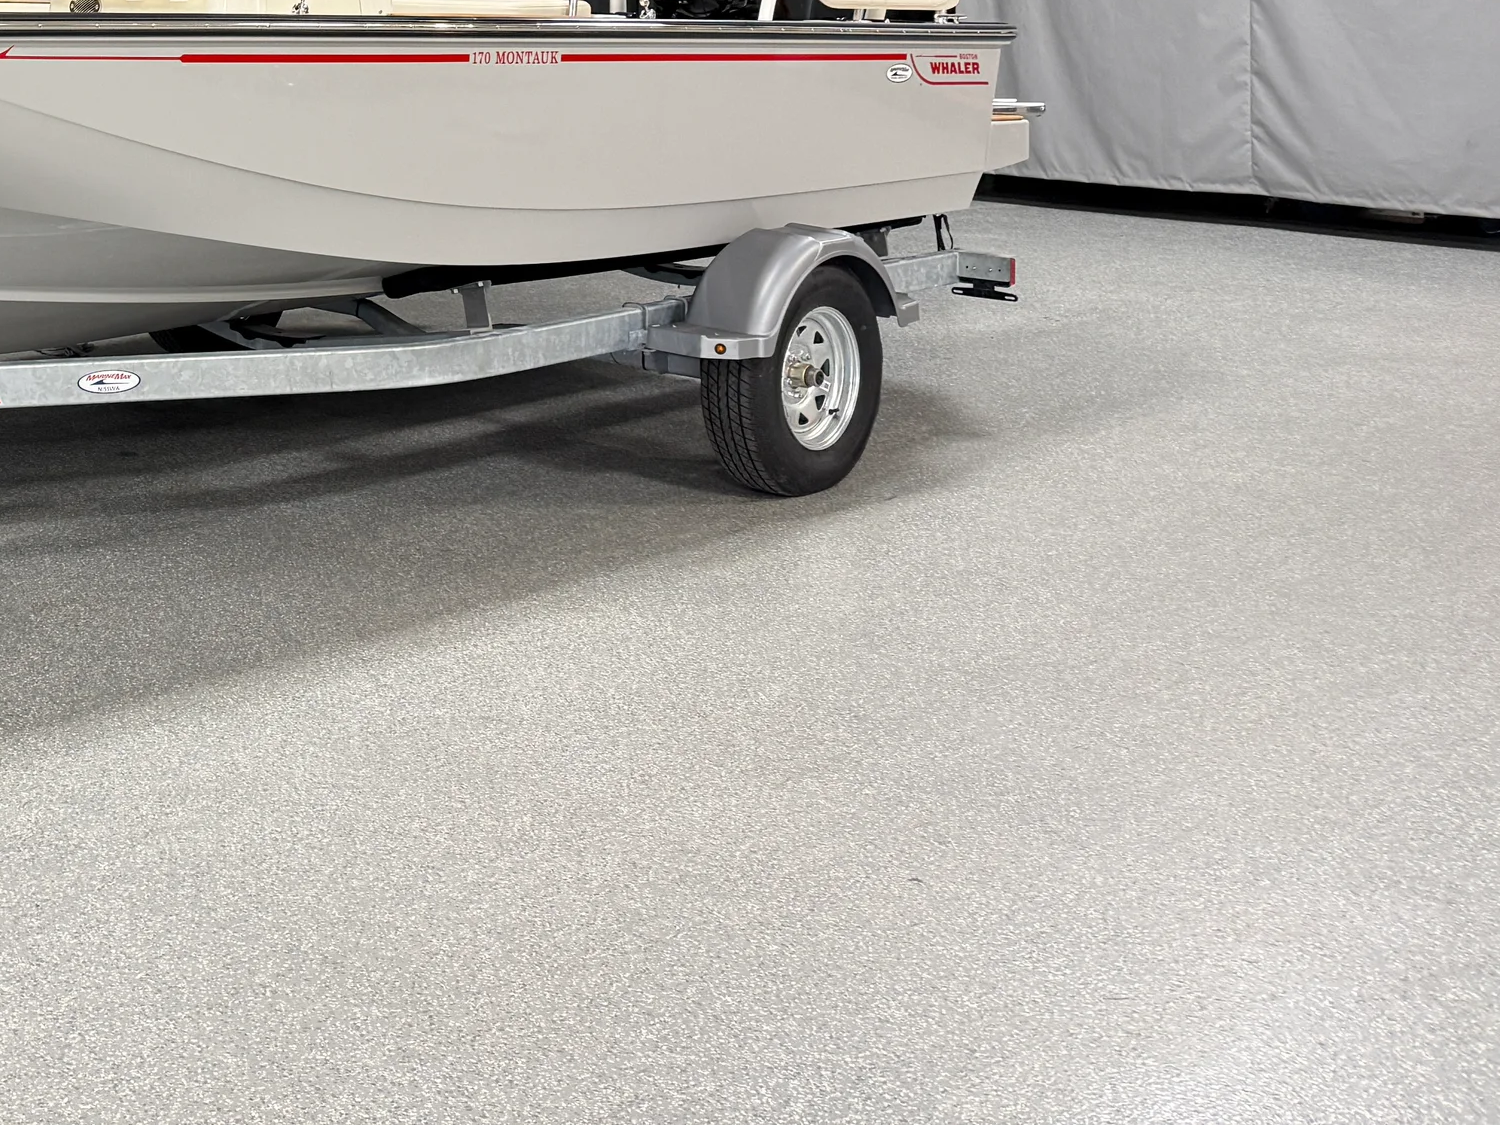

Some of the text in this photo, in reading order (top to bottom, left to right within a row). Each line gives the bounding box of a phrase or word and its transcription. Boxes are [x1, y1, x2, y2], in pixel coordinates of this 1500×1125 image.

[472, 50, 559, 65] 170 MONTAUK
[929, 62, 980, 75] WHALER
